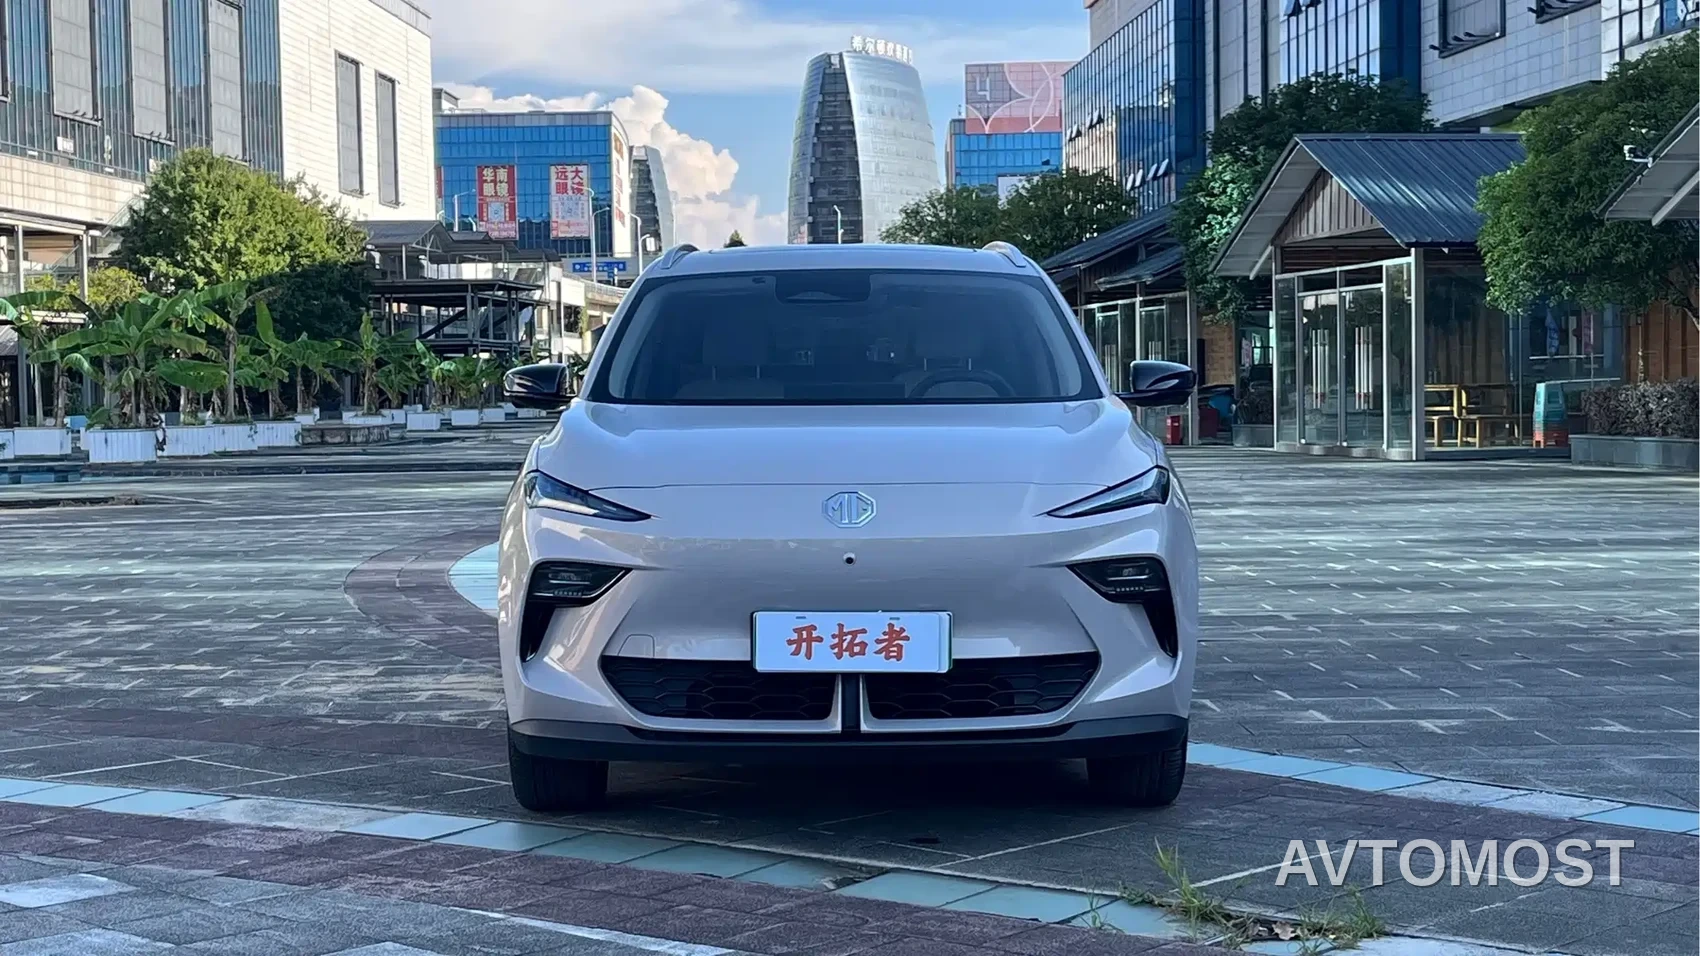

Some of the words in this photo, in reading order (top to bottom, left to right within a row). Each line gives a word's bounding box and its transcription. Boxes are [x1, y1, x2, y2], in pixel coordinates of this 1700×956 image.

[482, 167, 508, 183] 华南
[554, 165, 583, 181] 远大
[483, 183, 509, 197] 眼镜
[555, 181, 585, 195] 眼镜
[827, 493, 872, 523] MG
[785, 622, 911, 662] 开拓者
